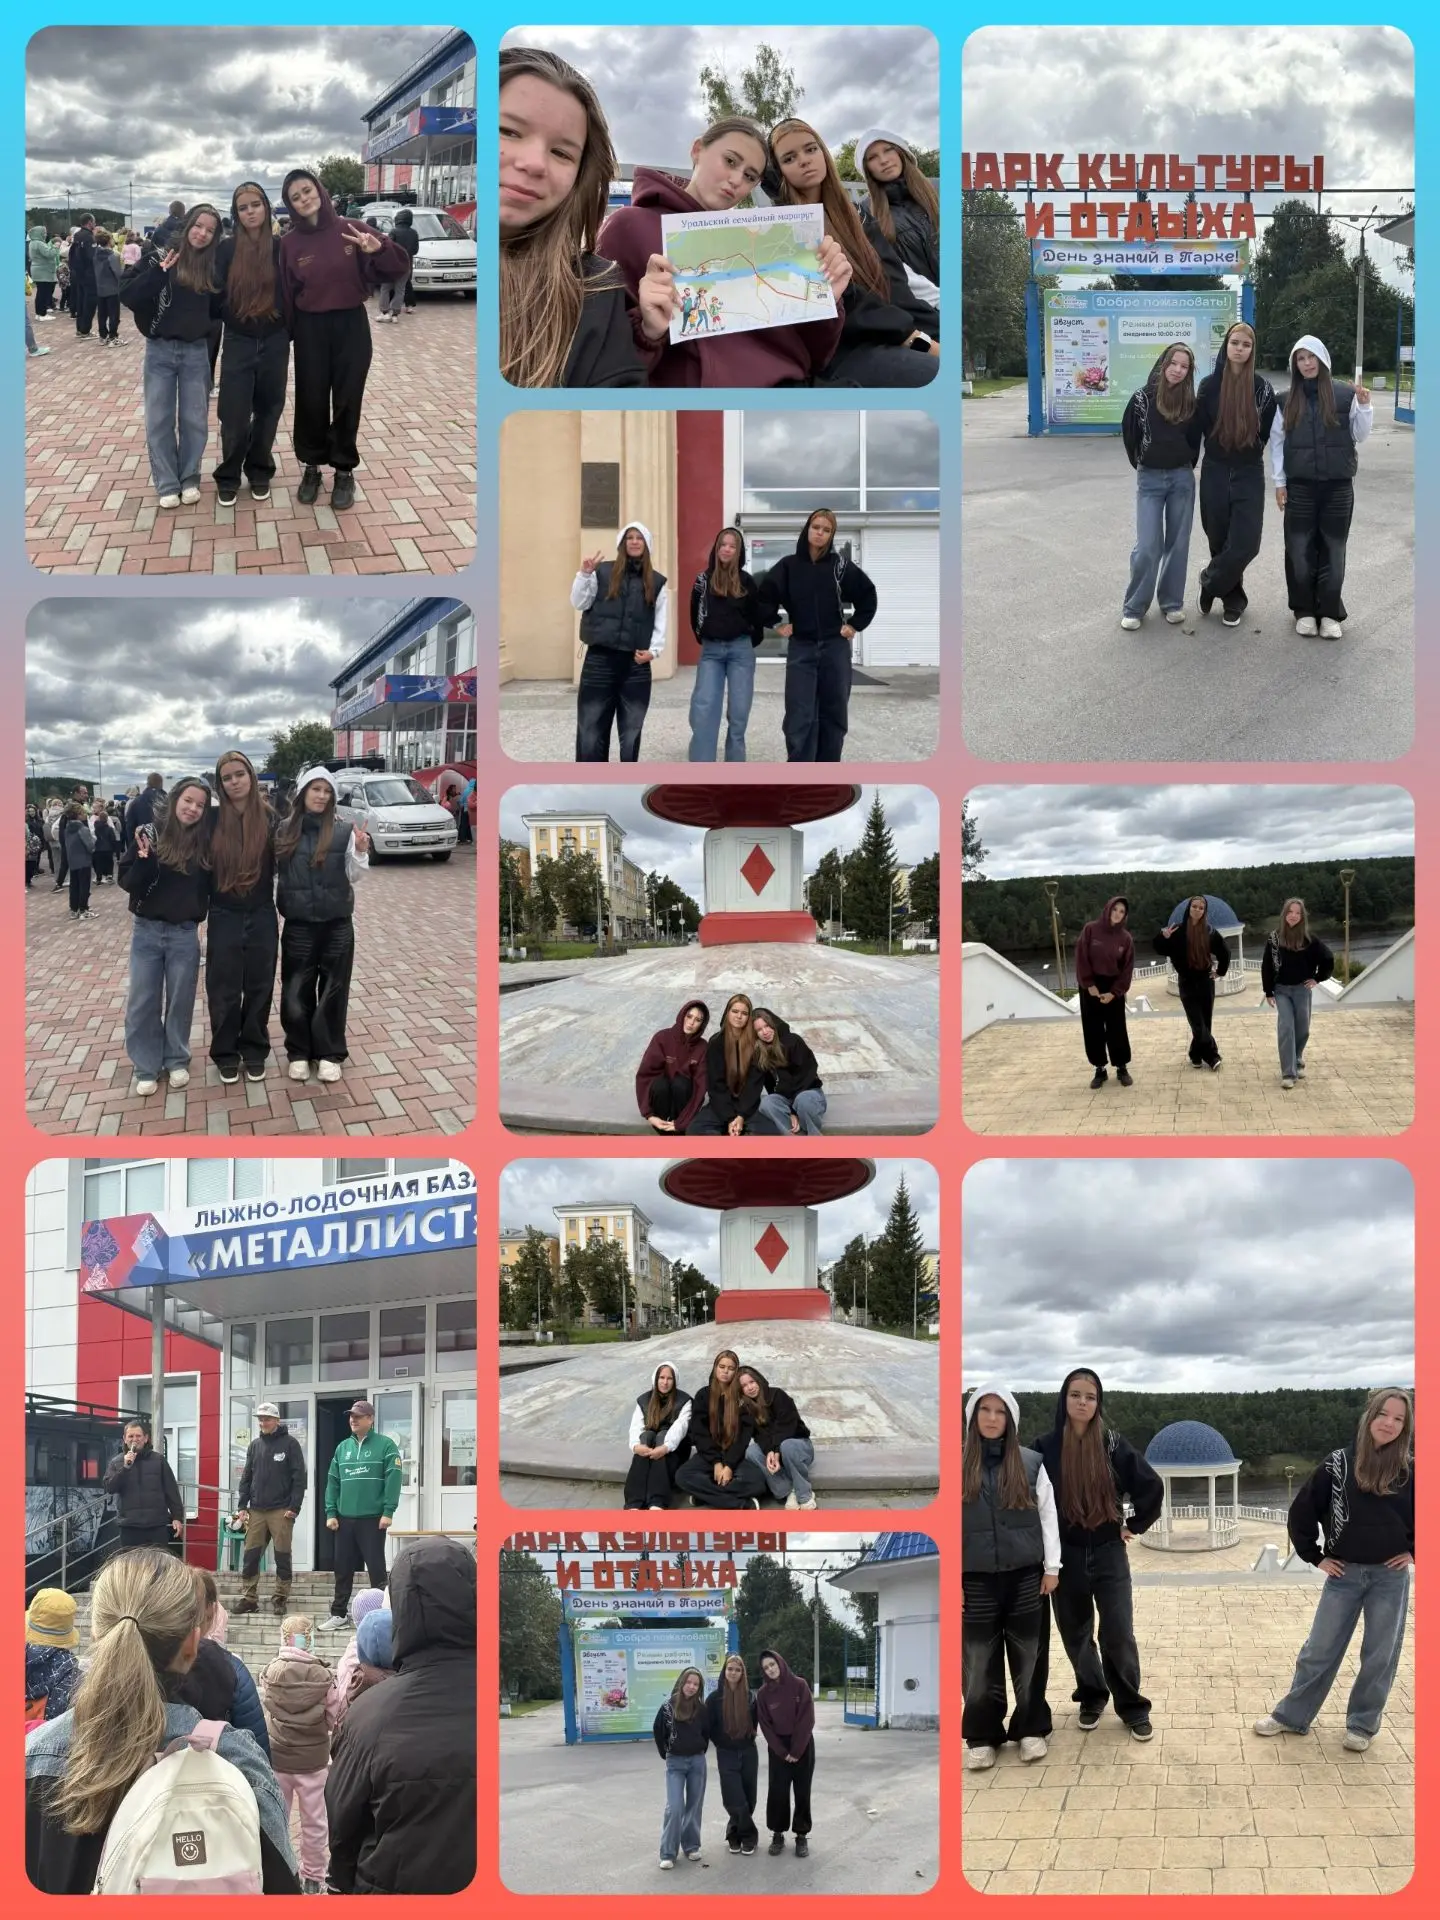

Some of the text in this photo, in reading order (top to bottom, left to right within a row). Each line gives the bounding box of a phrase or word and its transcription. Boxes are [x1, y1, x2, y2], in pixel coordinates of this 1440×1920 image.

[1078, 153, 1324, 192] КУЛЬТУРЫ
[681, 211, 814, 229] Уральский семейный маршрут
[1025, 202, 1257, 243] И ОТДЫХА
[1042, 249, 1239, 266] День знаний в Парке!
[1096, 296, 1143, 309] Добро
[1145, 296, 1227, 307] пожаловать!
[1053, 318, 1085, 328] Август
[1122, 320, 1193, 329] Режим работы
[194, 1179, 419, 1228] ЛЫЖНО-ЛОДОЧНАЯ
[556, 1560, 738, 1592] И ОТДЫХА
[572, 1598, 608, 1608] День
[612, 1598, 664, 1610] знаний
[680, 1597, 725, 1610] Парке!
[616, 1632, 651, 1643] Добро
[175, 1834, 202, 1843] HELLO
